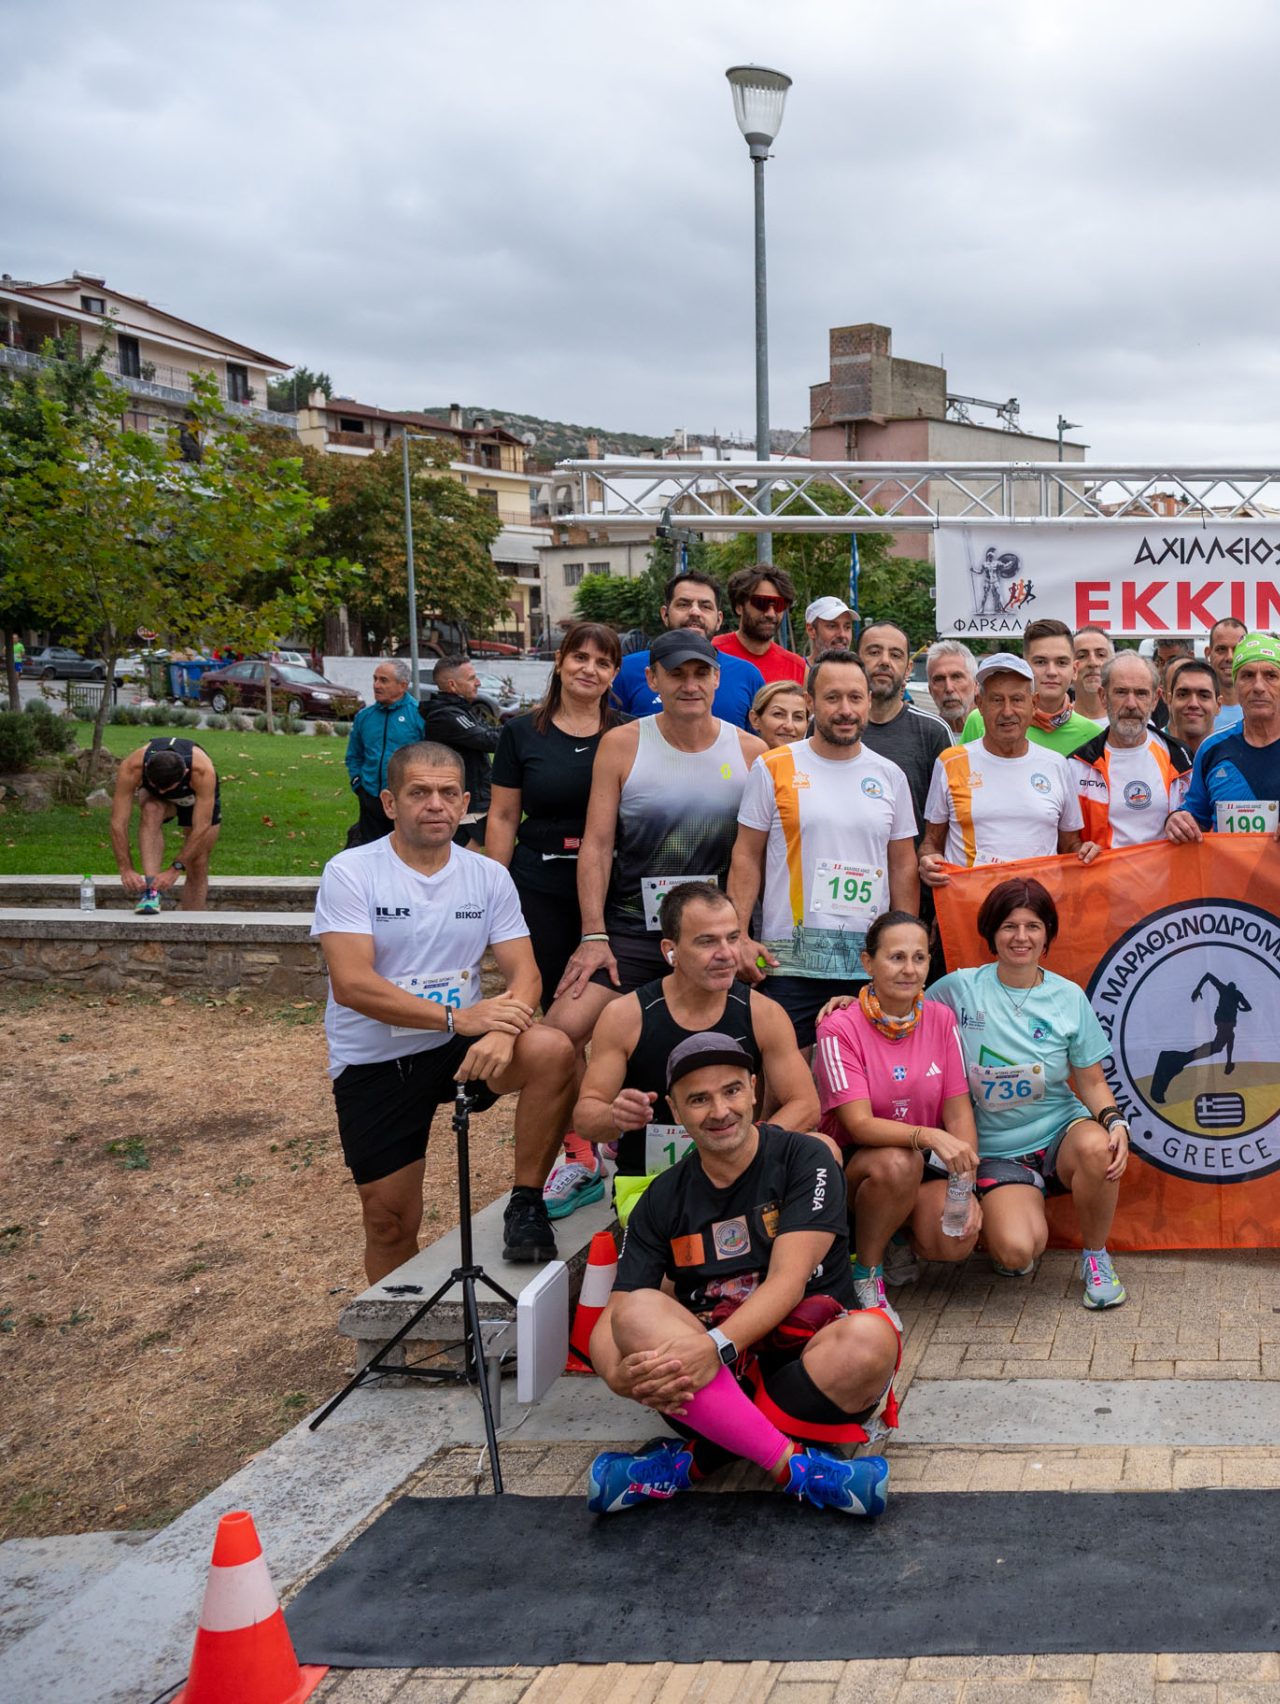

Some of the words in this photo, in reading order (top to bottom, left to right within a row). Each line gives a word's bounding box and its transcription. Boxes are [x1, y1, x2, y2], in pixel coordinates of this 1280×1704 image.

[828, 876, 873, 904] 195
[376, 907, 411, 917] ILR
[981, 1080, 1032, 1100] 736
[1163, 1137, 1272, 1168] GREECE
[812, 1168, 827, 1211] NASIA
